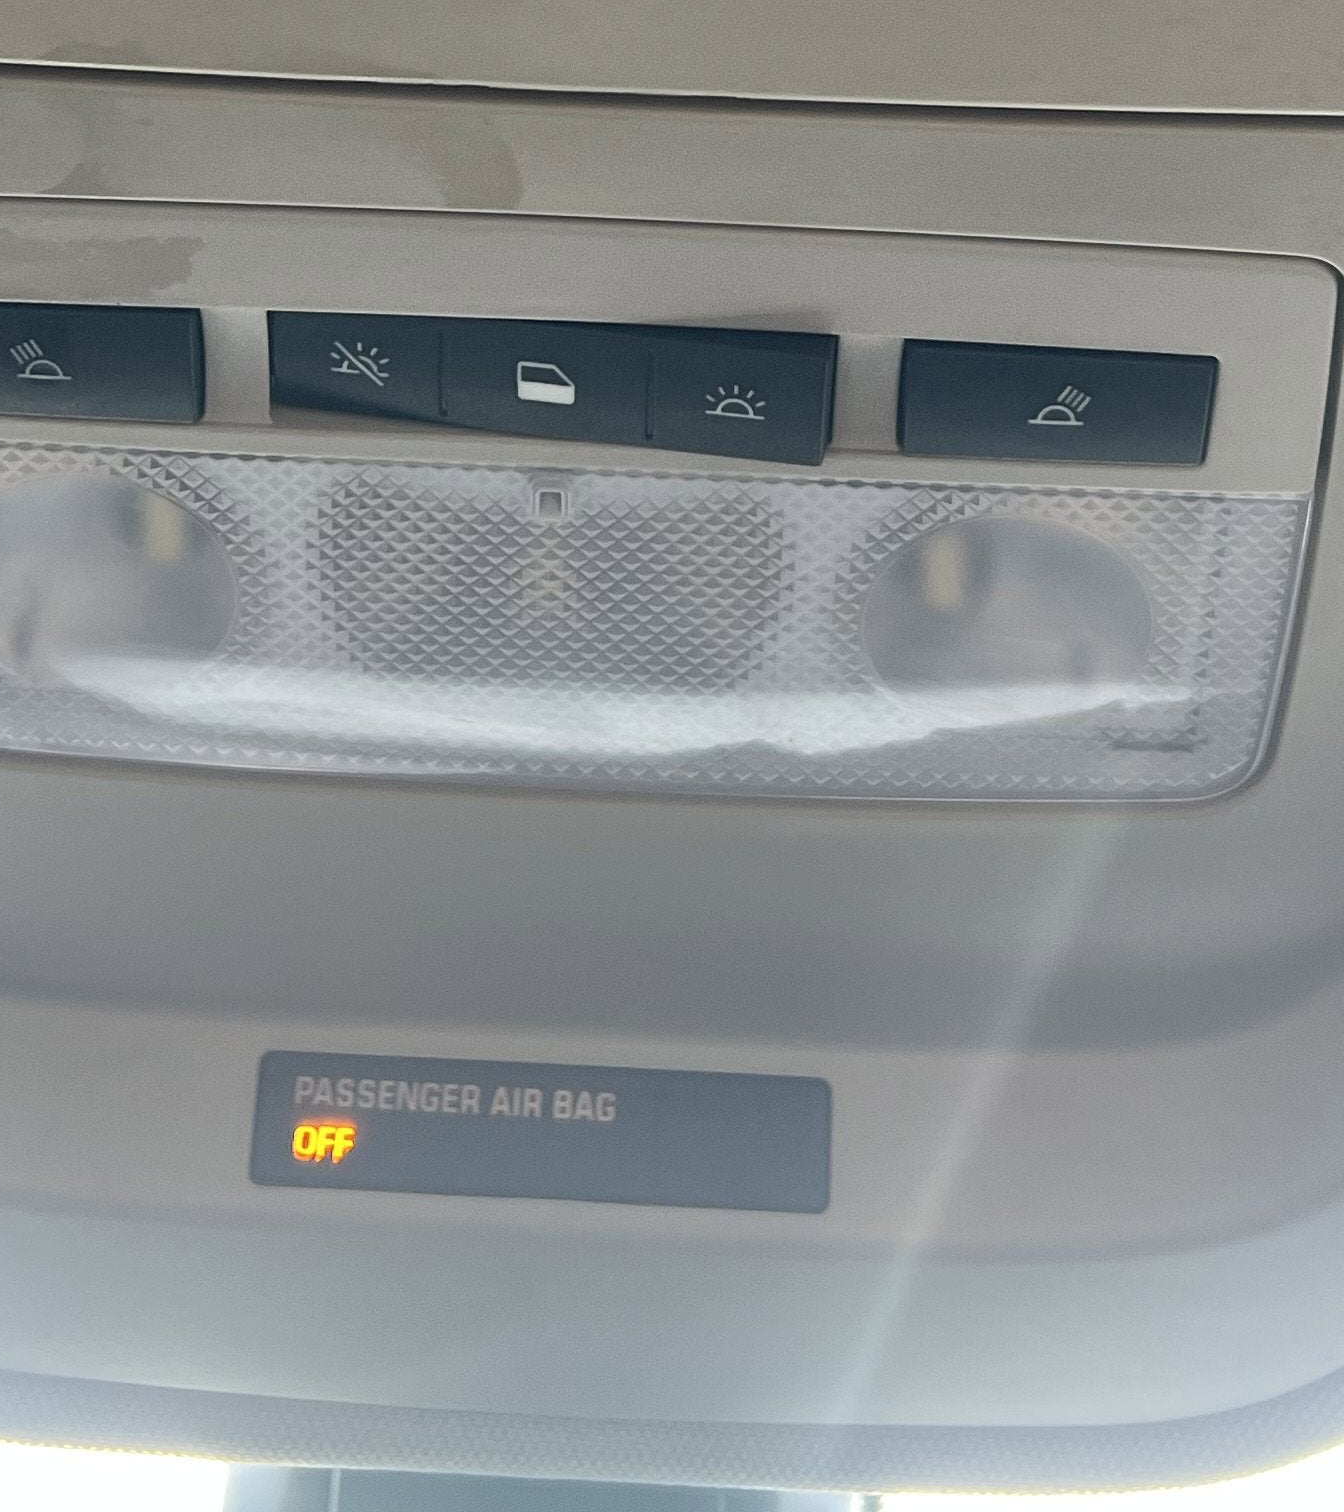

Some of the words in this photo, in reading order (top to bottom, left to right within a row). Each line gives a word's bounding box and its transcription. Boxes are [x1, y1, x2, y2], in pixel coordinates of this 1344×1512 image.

[293, 1075, 481, 1116] PASSENGER
[489, 1086, 543, 1119] AIR
[552, 1090, 617, 1123] BAG
[291, 1124, 356, 1163] OFF
